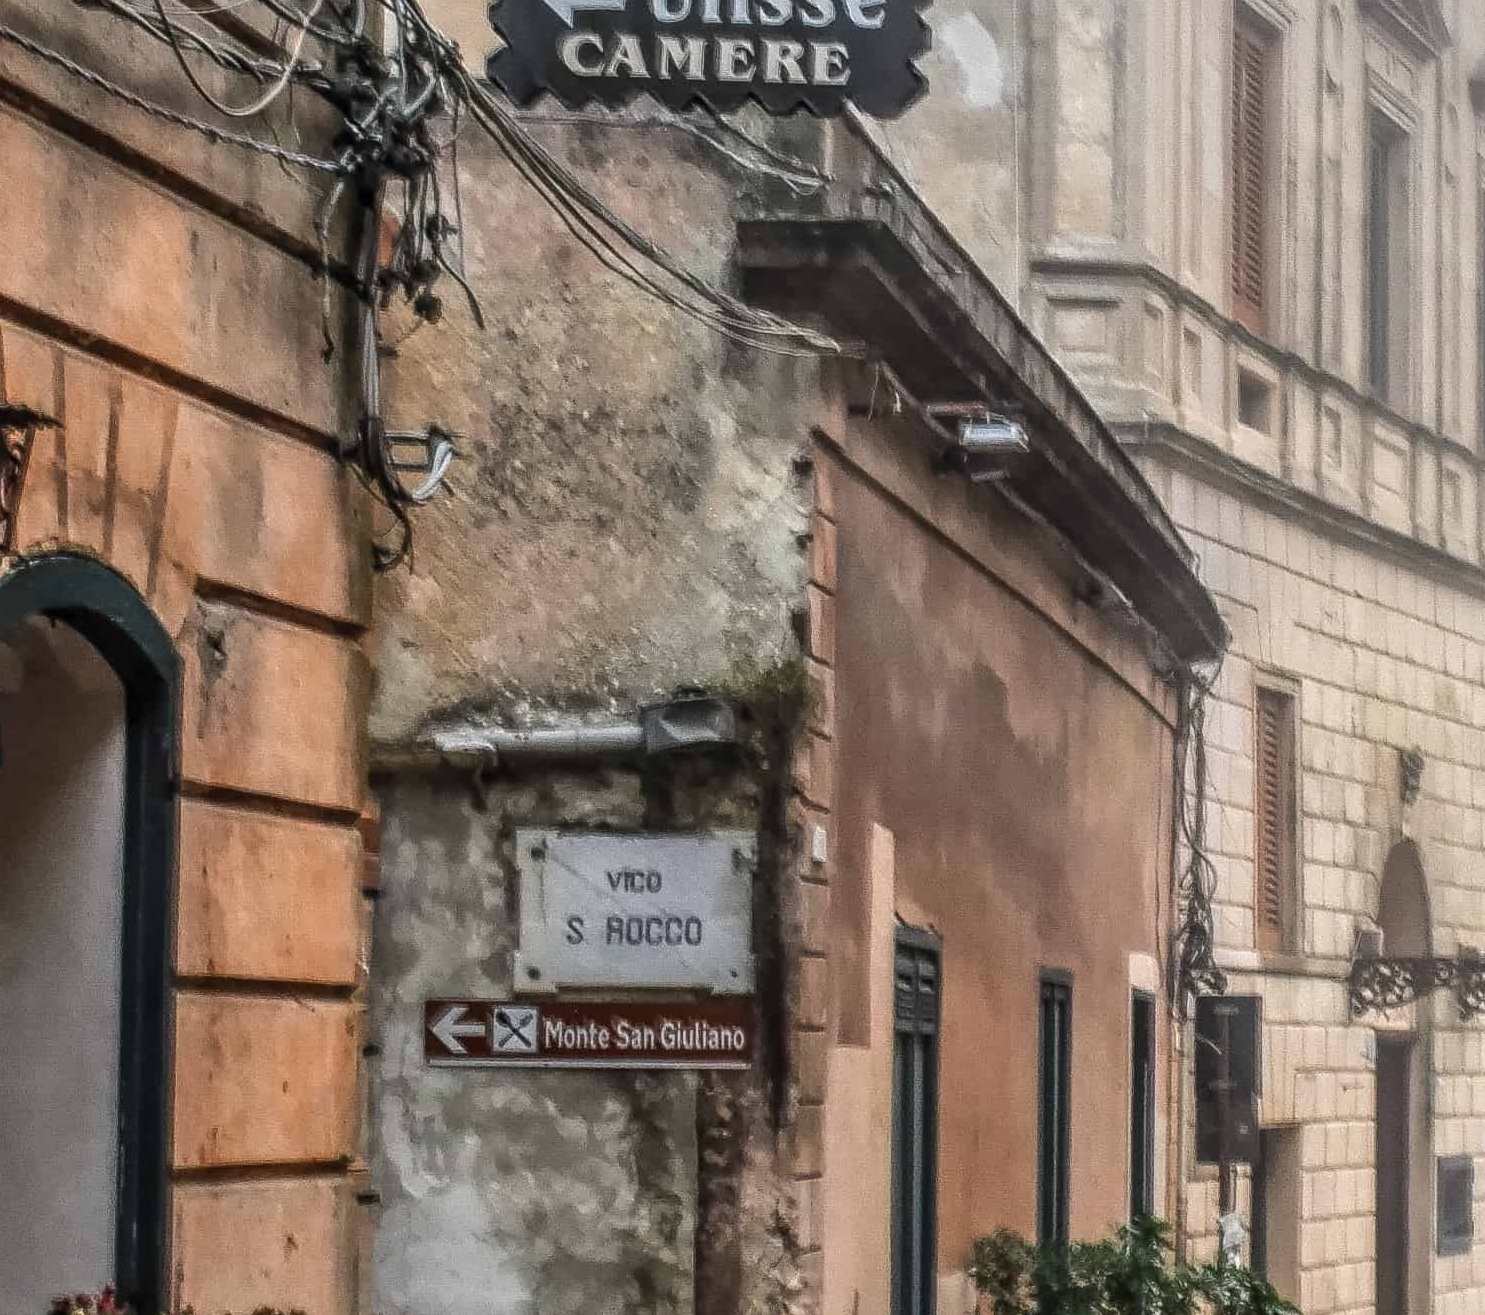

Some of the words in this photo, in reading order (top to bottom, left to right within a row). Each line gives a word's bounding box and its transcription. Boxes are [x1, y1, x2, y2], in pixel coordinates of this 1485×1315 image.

[557, 31, 851, 87] CAMERE
[606, 868, 662, 894] VICO
[606, 915, 703, 947] ROCCO
[544, 1020, 610, 1050] Monte
[616, 1021, 655, 1050] San
[661, 1021, 745, 1051] Giuliano
